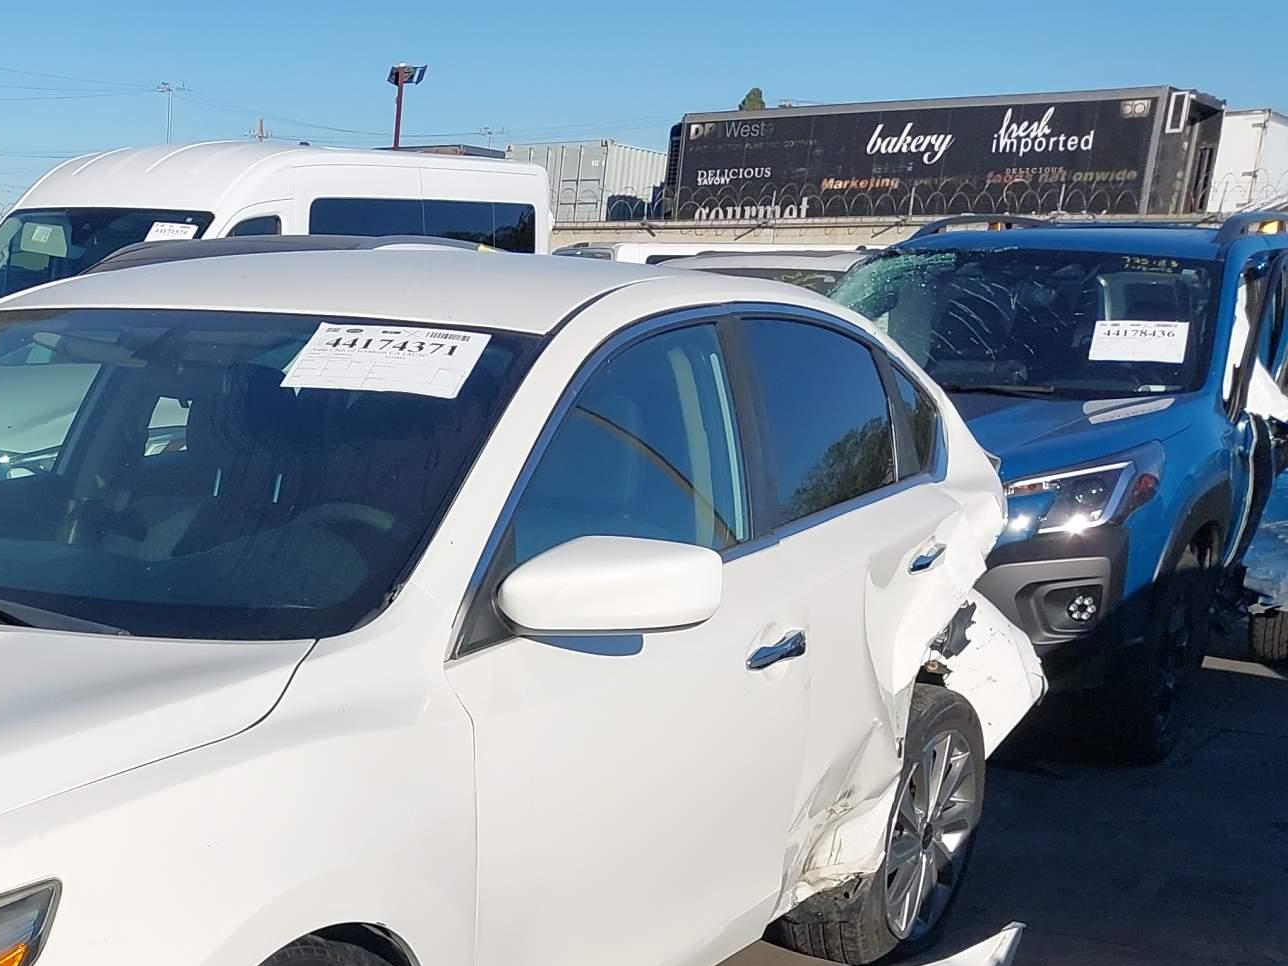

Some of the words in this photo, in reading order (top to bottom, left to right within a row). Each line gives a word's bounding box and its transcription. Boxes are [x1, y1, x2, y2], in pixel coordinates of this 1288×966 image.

[725, 120, 767, 138] West
[997, 106, 1056, 144] fresh
[866, 122, 955, 165] bakery
[991, 130, 1095, 157] imported
[697, 167, 772, 180] DELICIOUS
[1005, 166, 1064, 175] DELICIOUS
[821, 176, 901, 190] Marketing
[324, 336, 459, 357] 44174371
